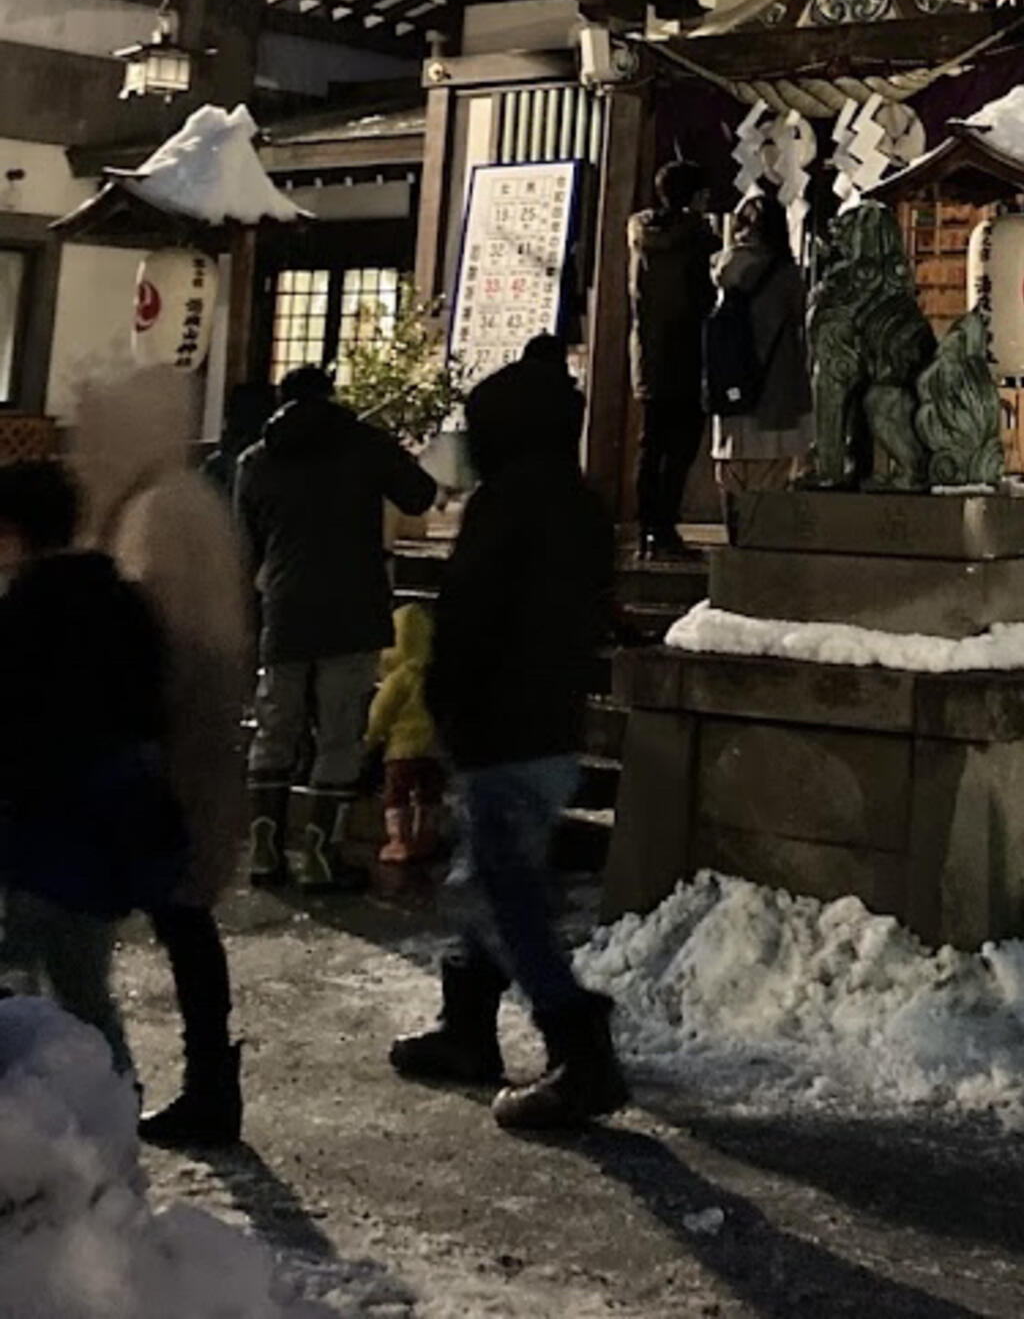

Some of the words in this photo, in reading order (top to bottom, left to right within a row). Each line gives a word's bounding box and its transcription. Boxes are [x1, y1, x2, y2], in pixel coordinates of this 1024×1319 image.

[520, 206, 537, 222] 25
[488, 241, 506, 258] 32
[484, 277, 501, 293] 33
[510, 277, 528, 293] 42
[479, 314, 496, 329] 34
[506, 313, 523, 329] 43
